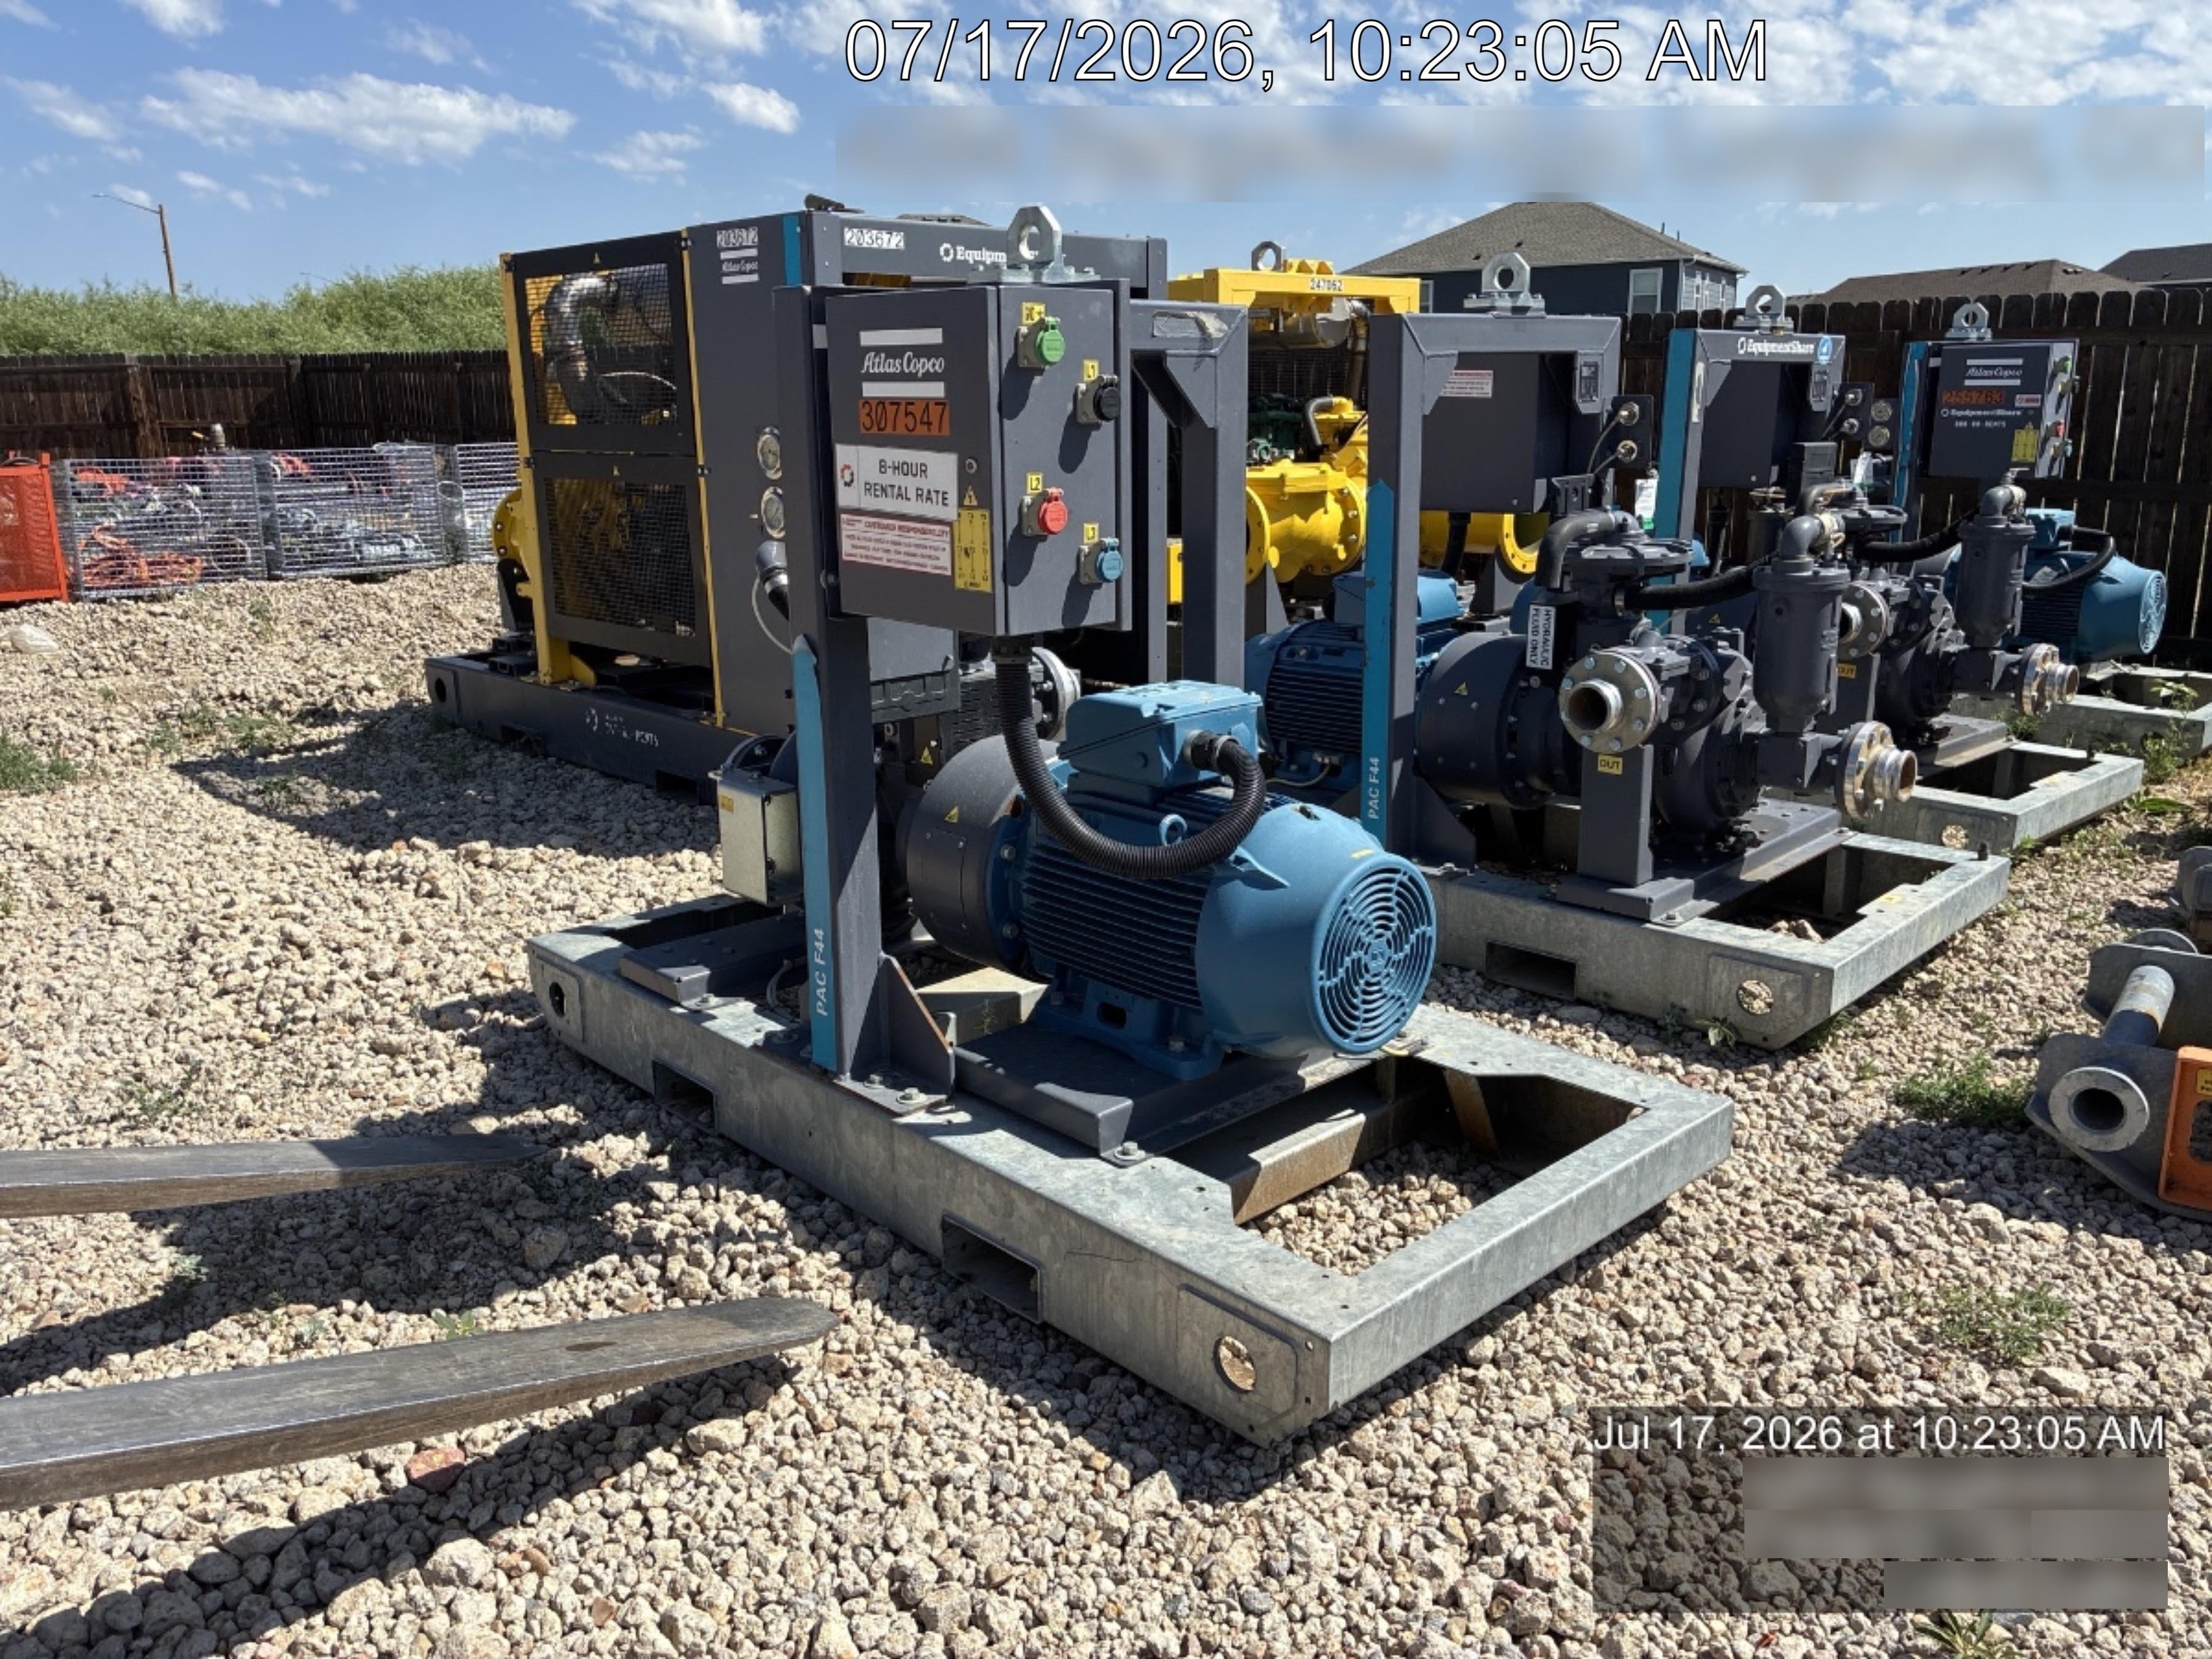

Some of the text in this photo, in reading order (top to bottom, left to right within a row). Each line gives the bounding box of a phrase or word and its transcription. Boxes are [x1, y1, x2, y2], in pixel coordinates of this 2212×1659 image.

[844, 229, 904, 248] 203672
[956, 246, 1007, 264] Equipm
[861, 401, 947, 433] 307547
[864, 482, 949, 507] RENTAL RATE
[1030, 477, 1040, 491] L2
[1599, 759, 1620, 770] OUT
[1368, 756, 1380, 819] PAC F44
[814, 928, 828, 1017] PAC F44
